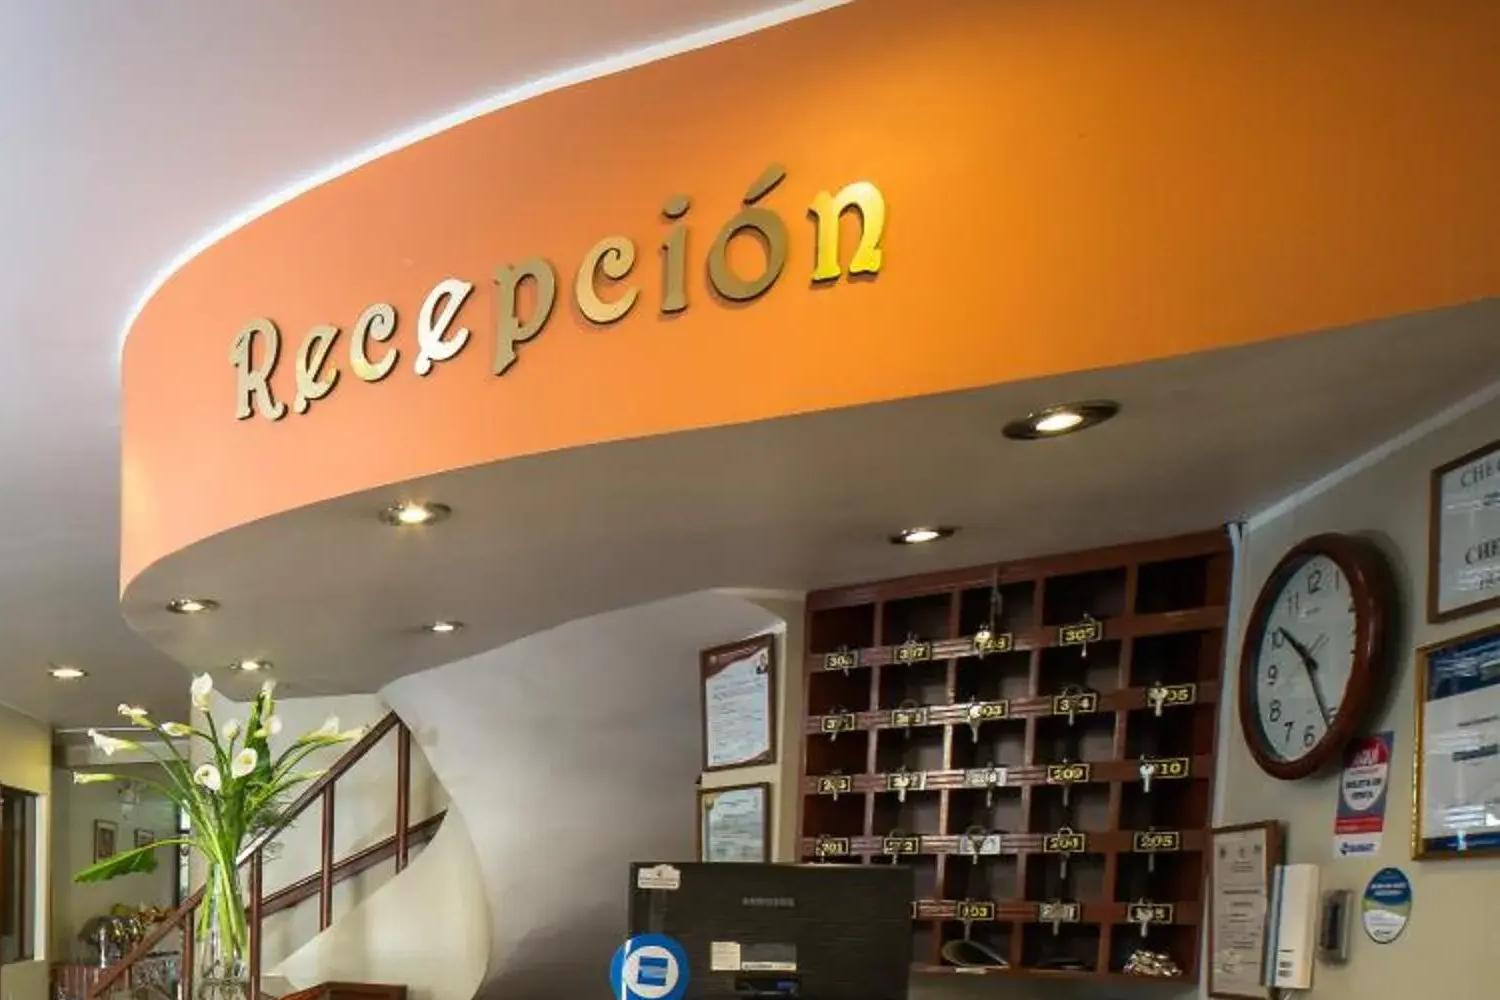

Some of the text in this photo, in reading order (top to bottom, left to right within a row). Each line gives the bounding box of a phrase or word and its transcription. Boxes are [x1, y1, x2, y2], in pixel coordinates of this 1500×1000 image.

[231, 163, 886, 420] Recepción
[1268, 665, 1278, 685] 9
[1059, 698, 1089, 711] 34
[1269, 700, 1282, 722] 8
[1284, 721, 1294, 742] 7
[1304, 725, 1315, 747] 6
